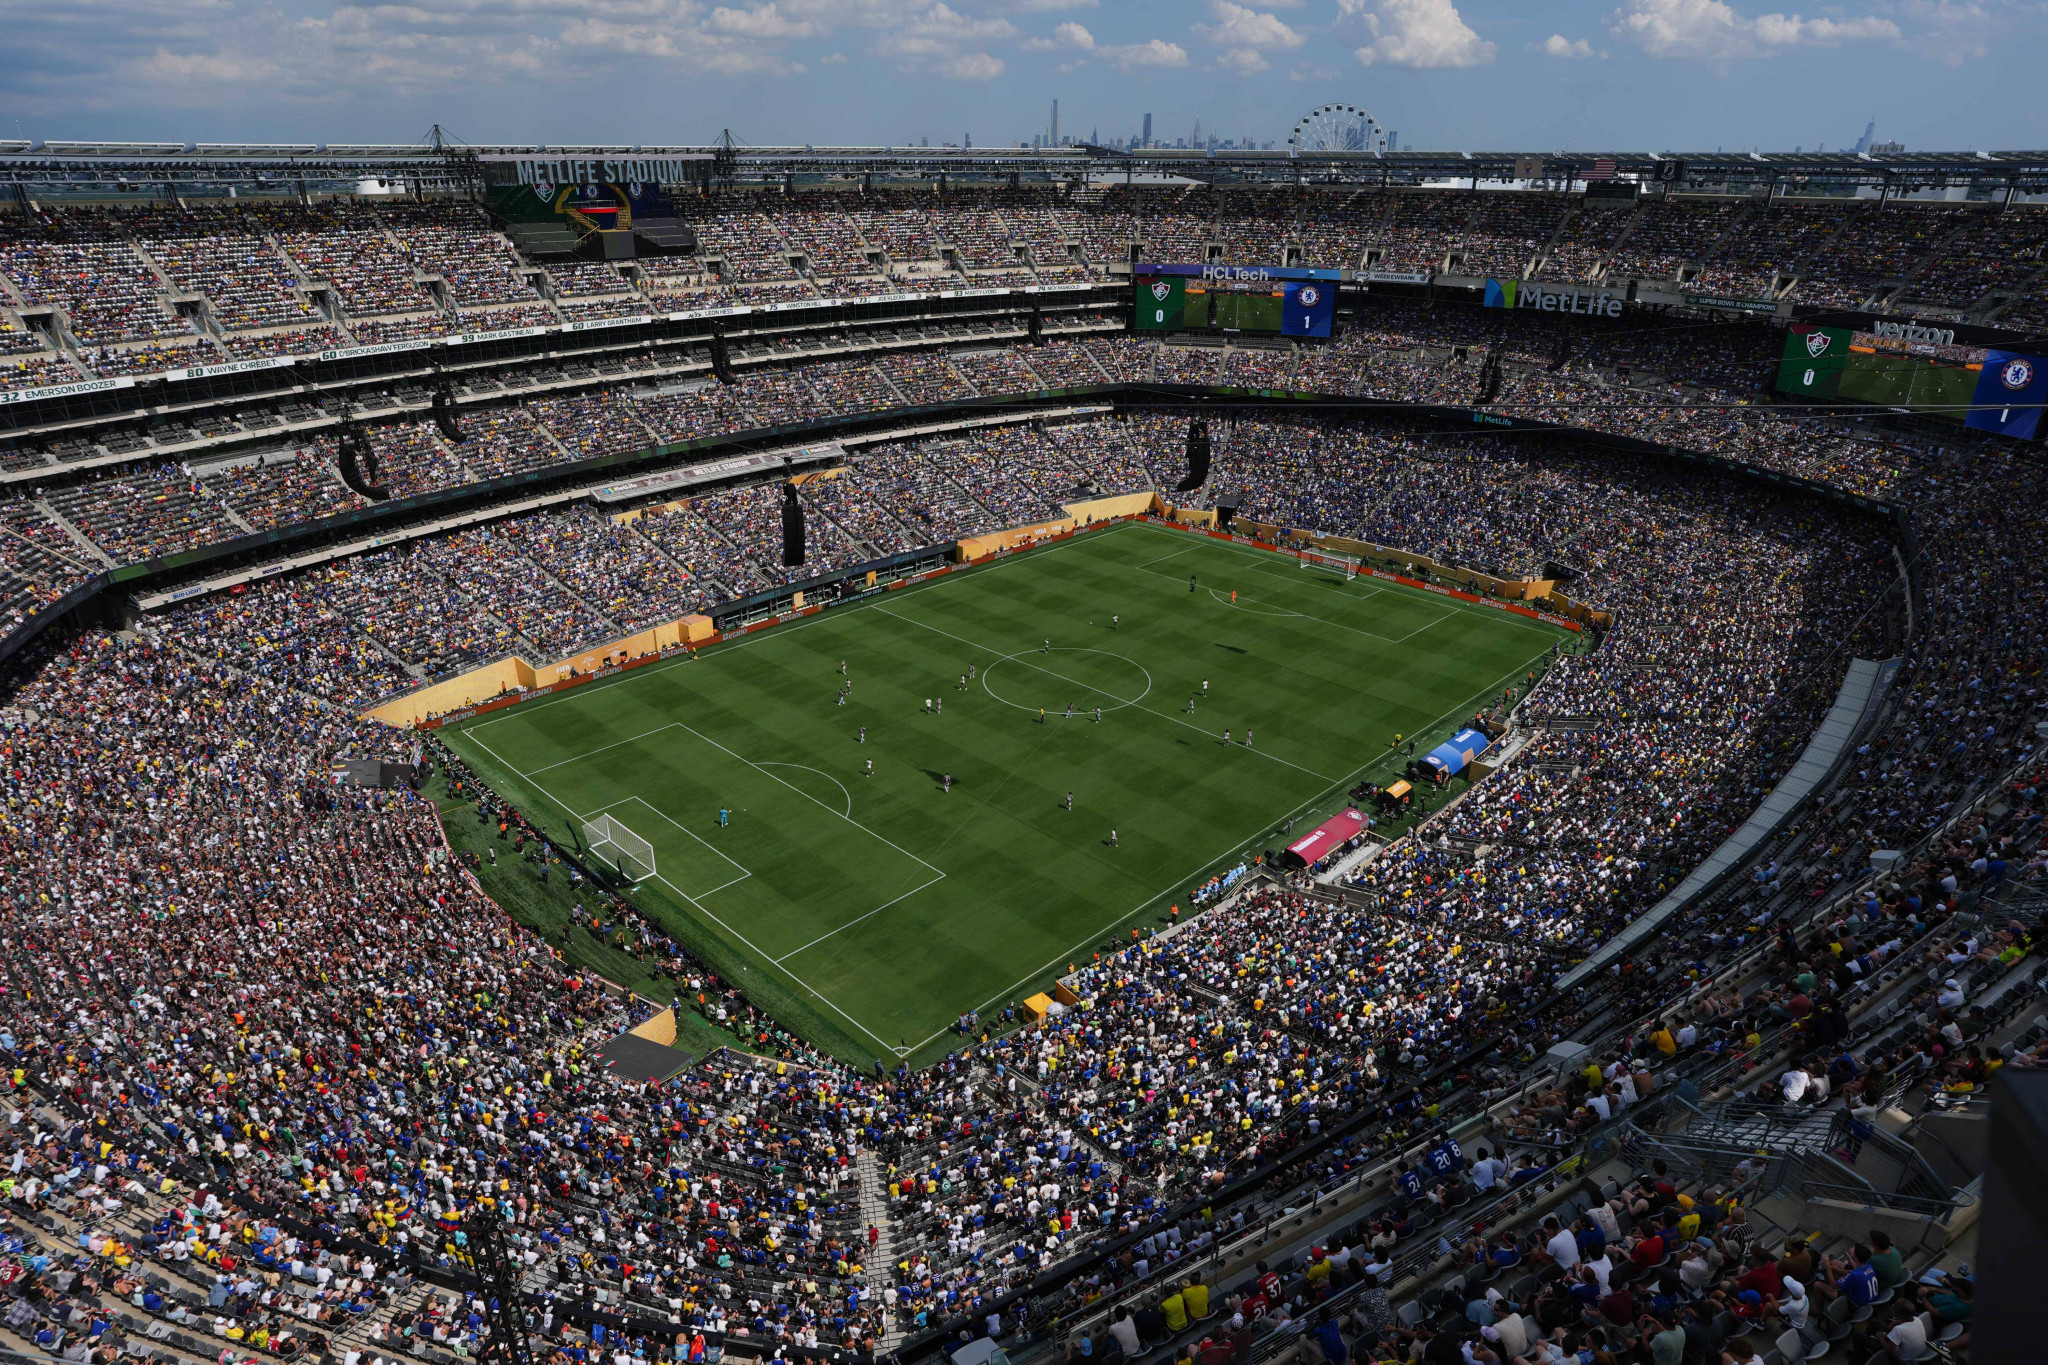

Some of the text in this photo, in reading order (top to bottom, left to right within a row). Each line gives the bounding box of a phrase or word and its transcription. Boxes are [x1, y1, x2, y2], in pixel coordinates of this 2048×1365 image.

[516, 160, 684, 185] METLIFE STADIUM
[1203, 266, 1269, 281] HCLTech
[1519, 286, 1623, 318] MetLife
[1699, 298, 1717, 306] SUPER
[1741, 302, 1777, 311] CHAMPIONS
[705, 309, 719, 317] LEON
[1155, 309, 1164, 323] 0
[572, 317, 642, 331] 60 LARRY GRANTHAM
[1304, 315, 1310, 329] 1
[461, 328, 534, 343] 99 MARK GASTINEAU
[1874, 320, 1955, 347] verizon
[322, 340, 429, 360] 60 D'BRICKASHAW FERGUSON
[187, 359, 277, 378] 80 WAYNE CHREBET
[1803, 369, 1815, 386] 0
[25, 384, 76, 400] EMERSON
[77, 380, 117, 392] BOOZER
[2000, 404, 2010, 423] 1
[1484, 415, 1512, 427] MetLife
[809, 444, 831, 453] MetLife
[694, 459, 750, 476] METLIFE STADIUM
[613, 482, 638, 493] MetLife
[1877, 504, 1890, 514] VISA
[1147, 517, 1167, 527] Betano
[1034, 527, 1047, 535] VISA
[1188, 526, 1209, 536] Betano
[383, 535, 400, 543] MetLife
[1232, 536, 1253, 546] Betano
[1276, 547, 1298, 557] Betano
[952, 561, 971, 572] Betano
[1323, 557, 1346, 569] Betano
[262, 566, 283, 575] MOODY'S
[1372, 570, 1397, 581] Betano
[906, 574, 927, 586] Betano
[172, 587, 203, 600] BUD LIGHT
[1424, 583, 1450, 595] Betano
[838, 597, 849, 606] CLUB
[849, 593, 863, 603] WORLD
[863, 591, 873, 599] CUP
[1479, 597, 1507, 610] Betano
[780, 611, 804, 623] Betano
[1537, 613, 1565, 626] Betano
[722, 628, 747, 641] Betano
[660, 646, 688, 660] Betano
[556, 664, 571, 675] FIFA
[593, 665, 623, 680] Betano
[521, 686, 552, 701] Betano
[442, 709, 477, 726] Betano
[1451, 1144, 1461, 1157] 8
[1435, 1153, 1451, 1170] 20
[1689, 1225, 1697, 1234] 7
[1864, 1268, 1873, 1277] MATA
[1267, 1279, 1281, 1299] 37
[1867, 1276, 1879, 1300] 10
[1254, 1305, 1267, 1321] 21
